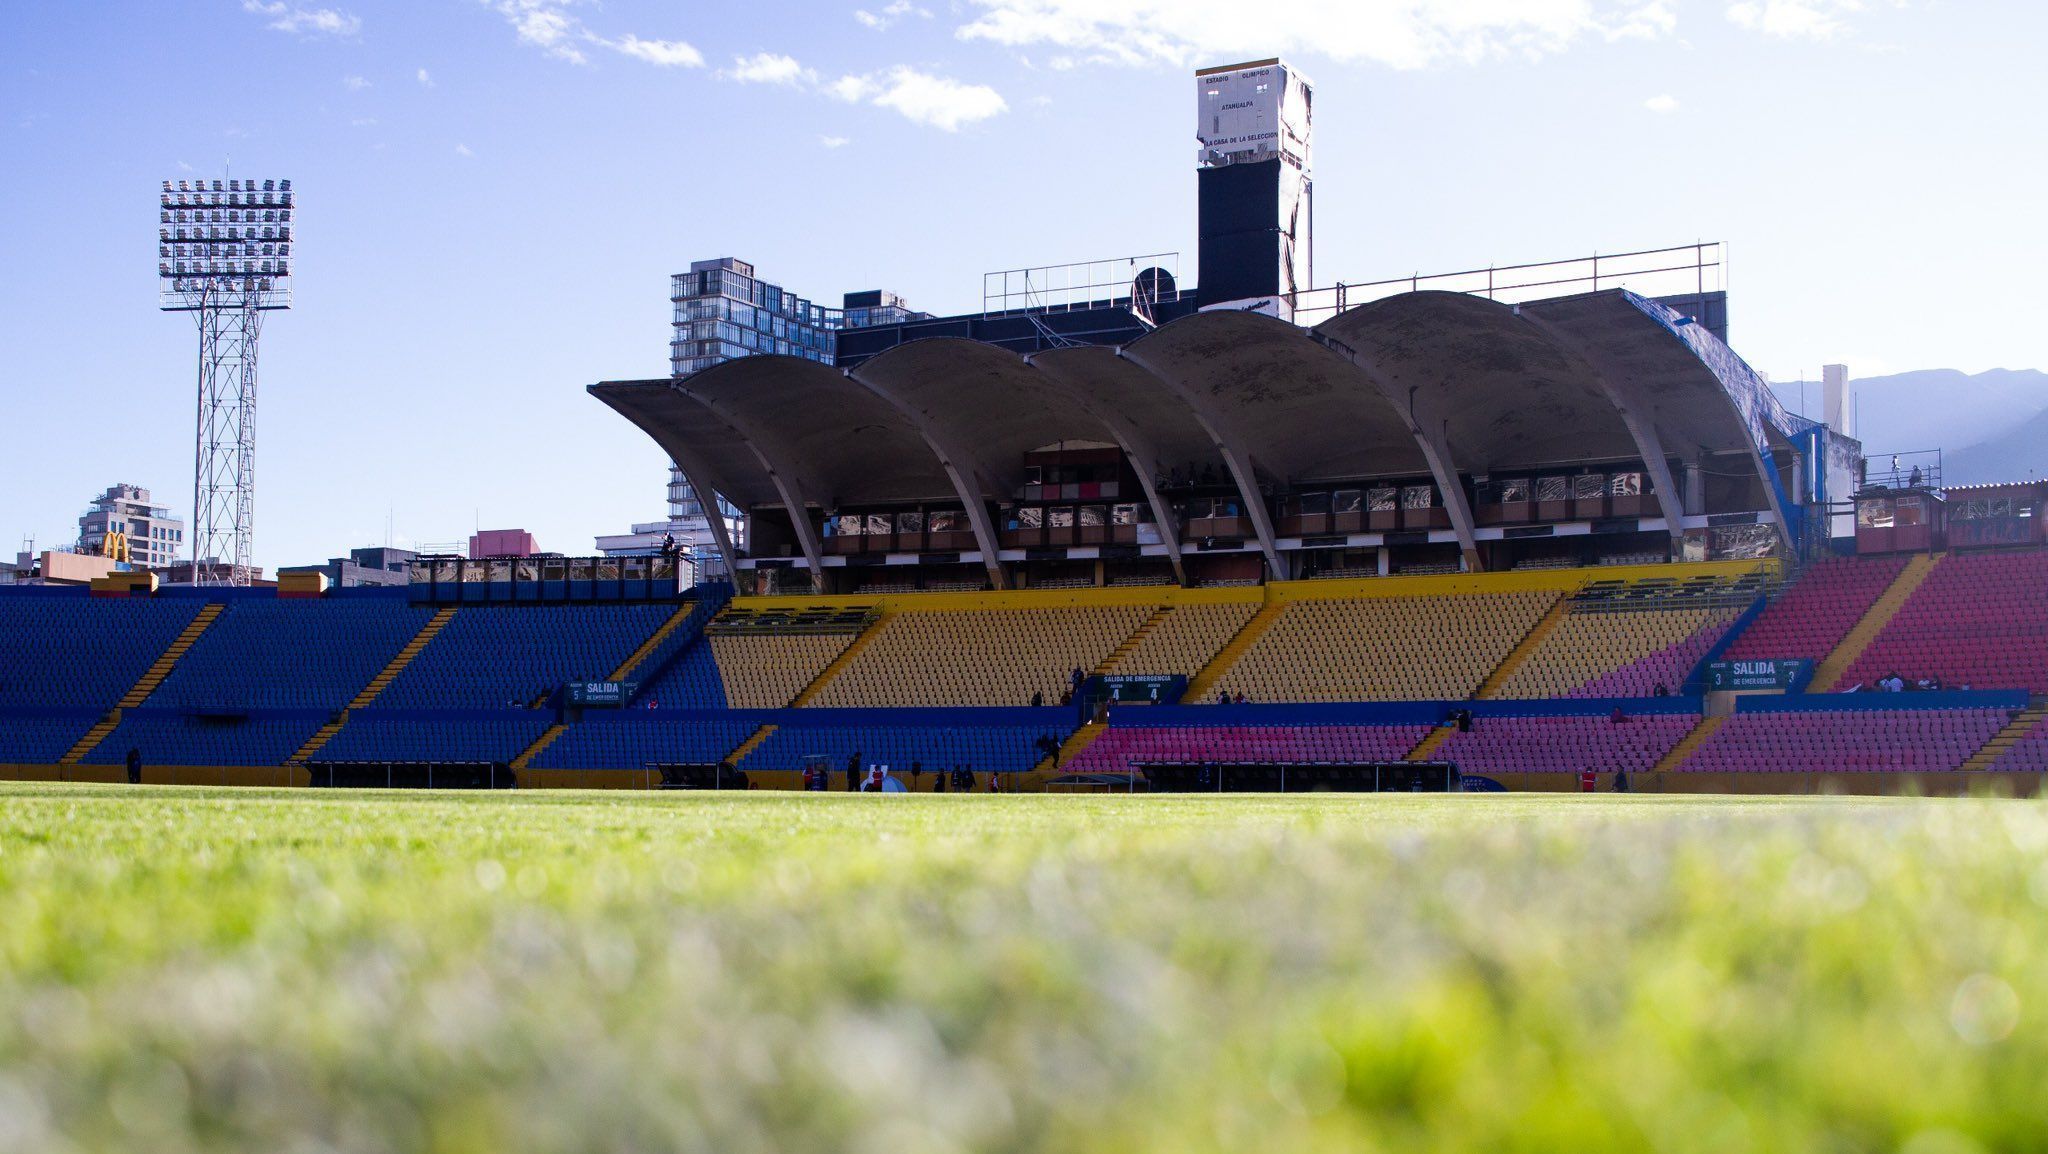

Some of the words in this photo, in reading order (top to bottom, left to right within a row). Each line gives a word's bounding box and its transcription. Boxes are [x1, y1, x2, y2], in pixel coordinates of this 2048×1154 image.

[1206, 76, 1229, 84] ESTADIO
[1242, 69, 1270, 79] OLIMPICO
[1221, 101, 1254, 111] ATAHUALPA
[1213, 138, 1229, 146] CASA
[1733, 662, 1776, 675] SALIDA
[1715, 673, 1721, 685] 3
[587, 683, 619, 693] SALIDA
[1150, 688, 1158, 700] 4
[573, 690, 580, 700] 5
[1113, 688, 1120, 701] 4
